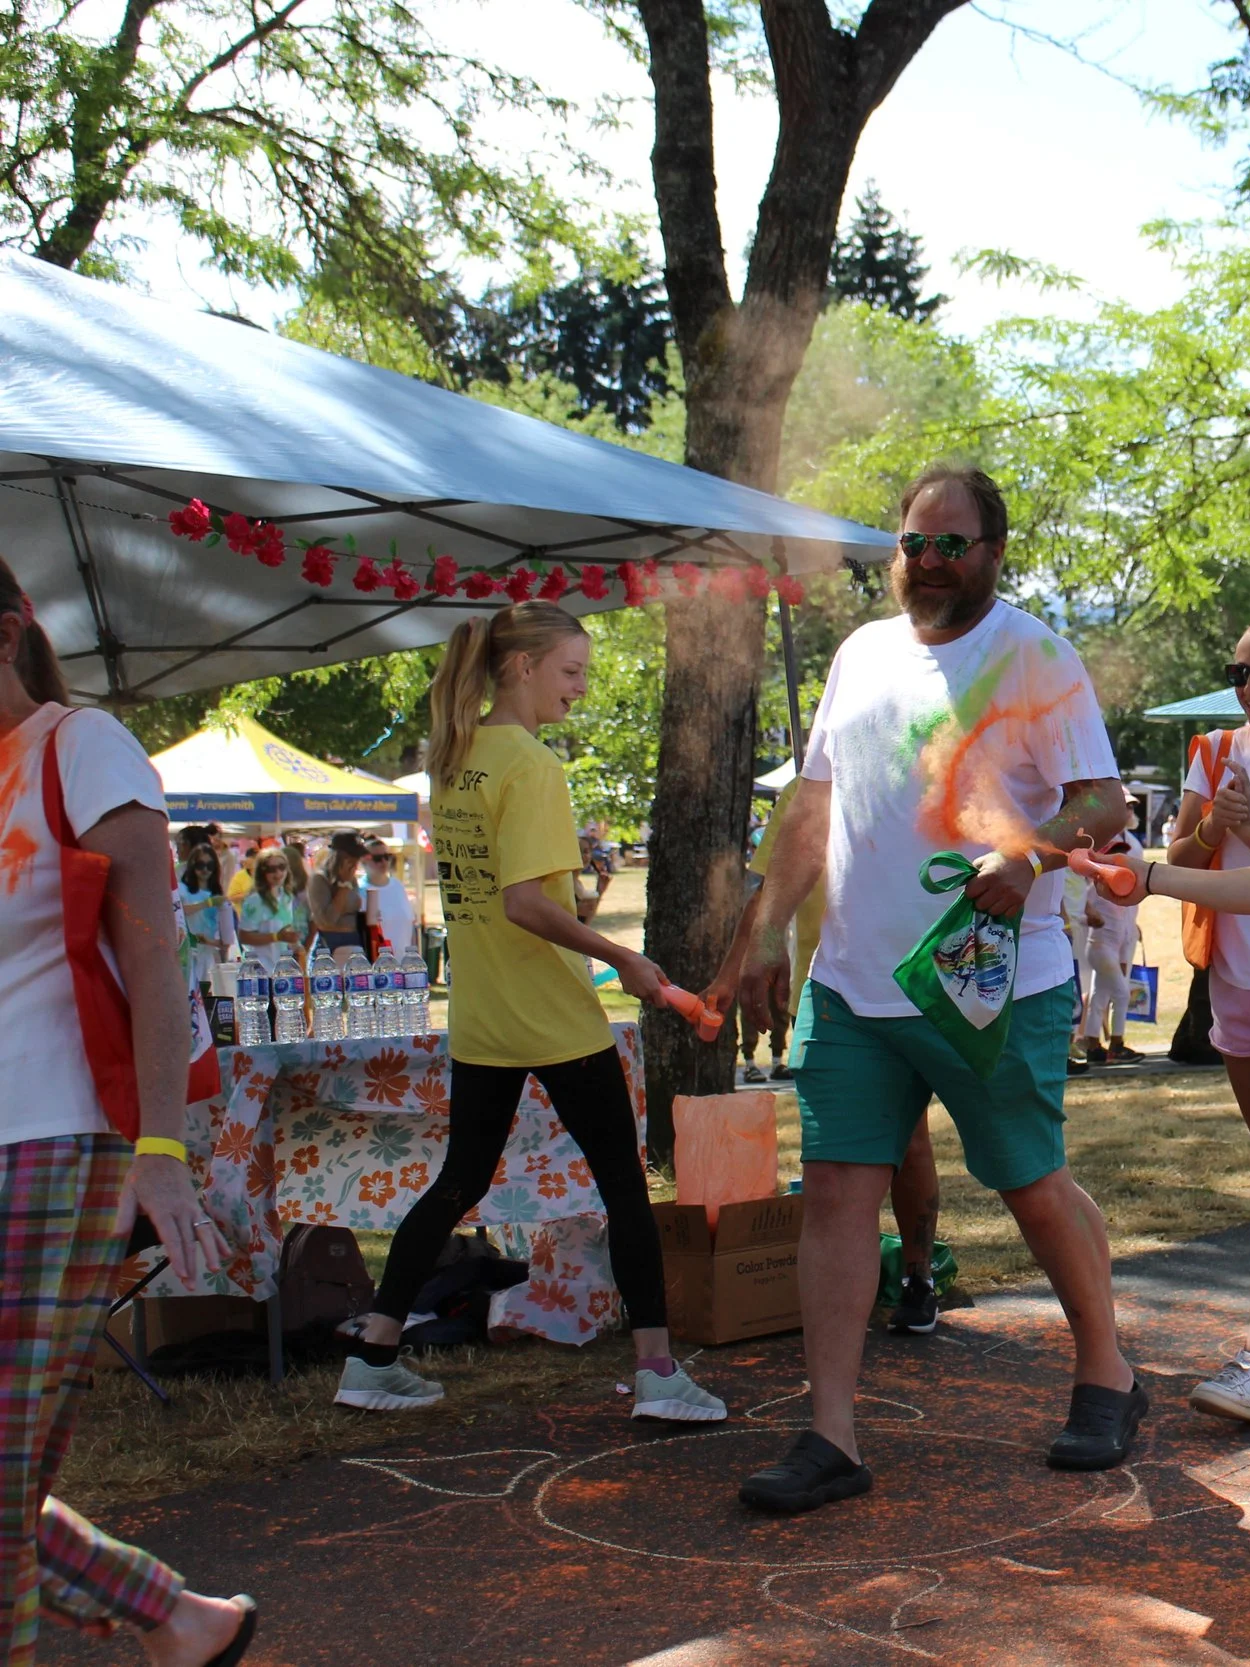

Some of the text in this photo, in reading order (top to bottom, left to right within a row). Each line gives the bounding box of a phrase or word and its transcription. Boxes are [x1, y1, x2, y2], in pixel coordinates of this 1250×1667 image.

[197, 800, 255, 811] Arrowsmith
[736, 1254, 798, 1275] Color Powde
